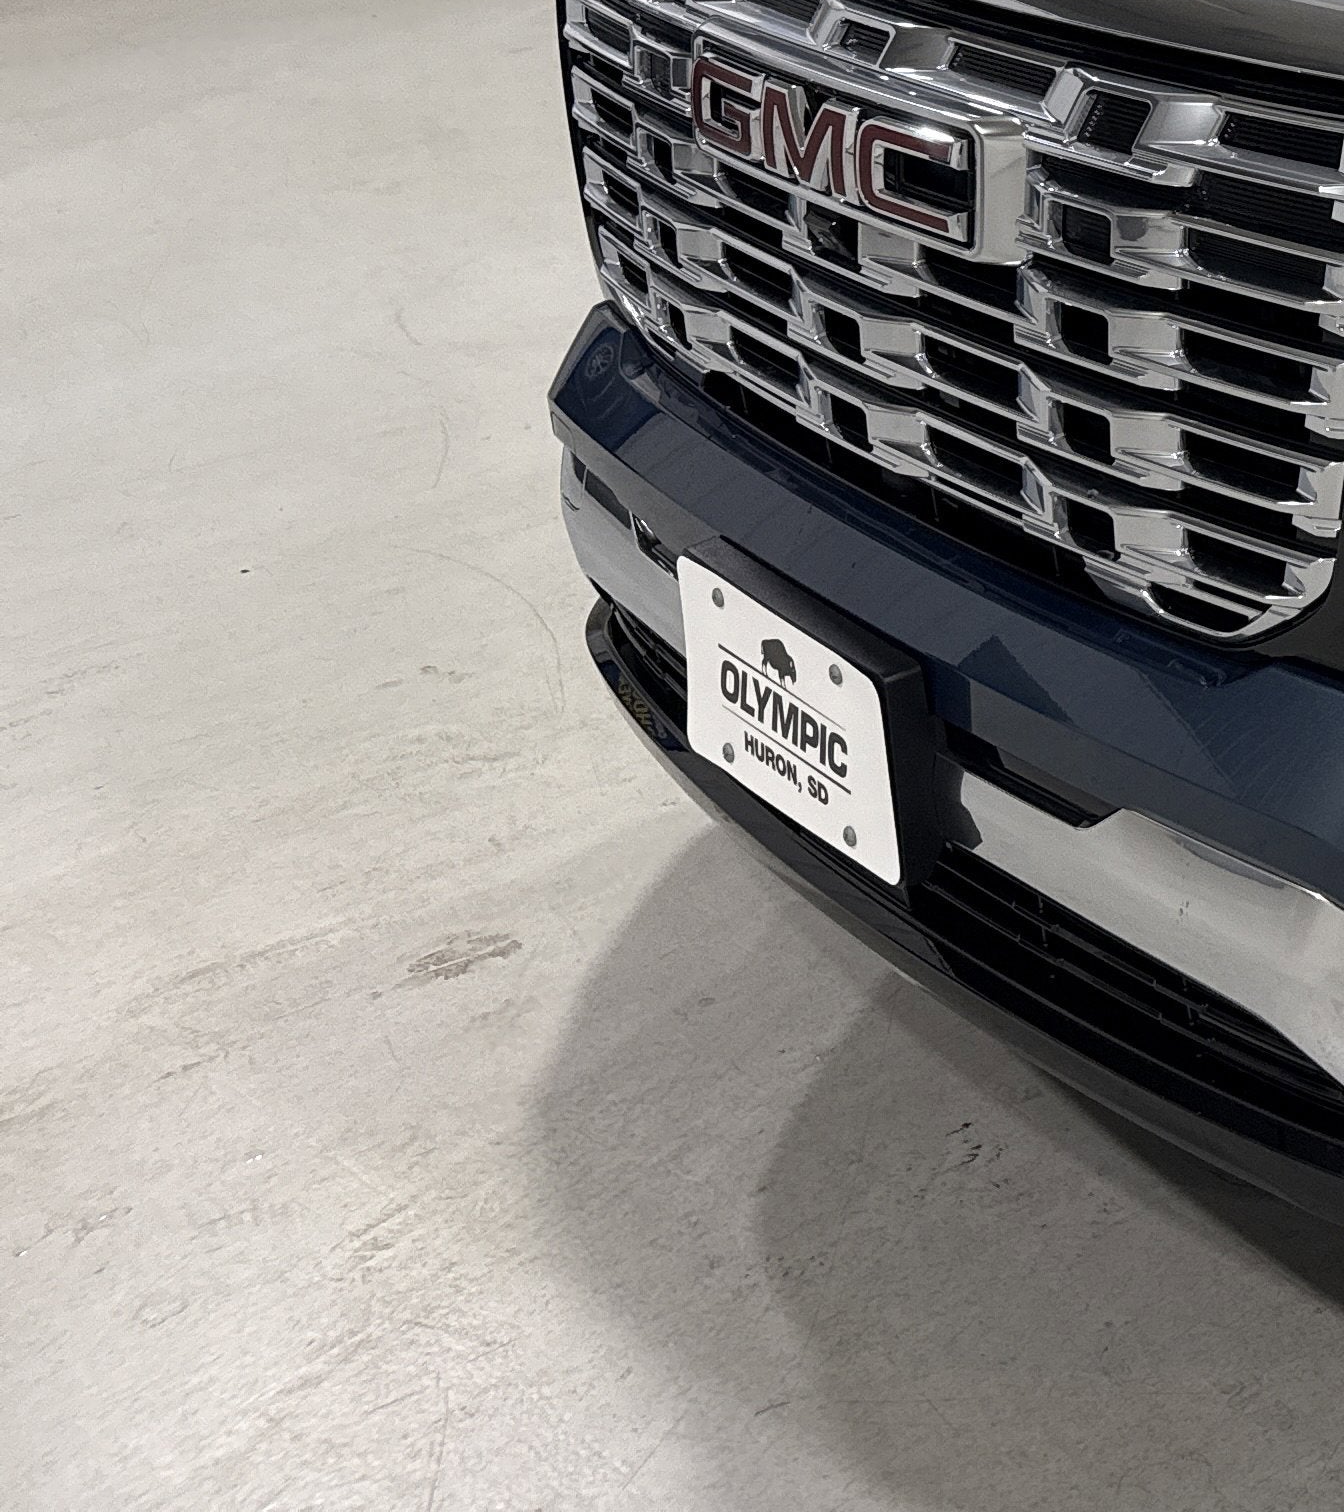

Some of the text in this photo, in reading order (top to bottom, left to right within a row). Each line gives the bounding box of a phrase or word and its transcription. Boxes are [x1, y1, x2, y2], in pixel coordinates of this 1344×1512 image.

[691, 55, 968, 242] GMC
[720, 659, 849, 779] OLYMPIC
[743, 731, 830, 806] HURON, SD
